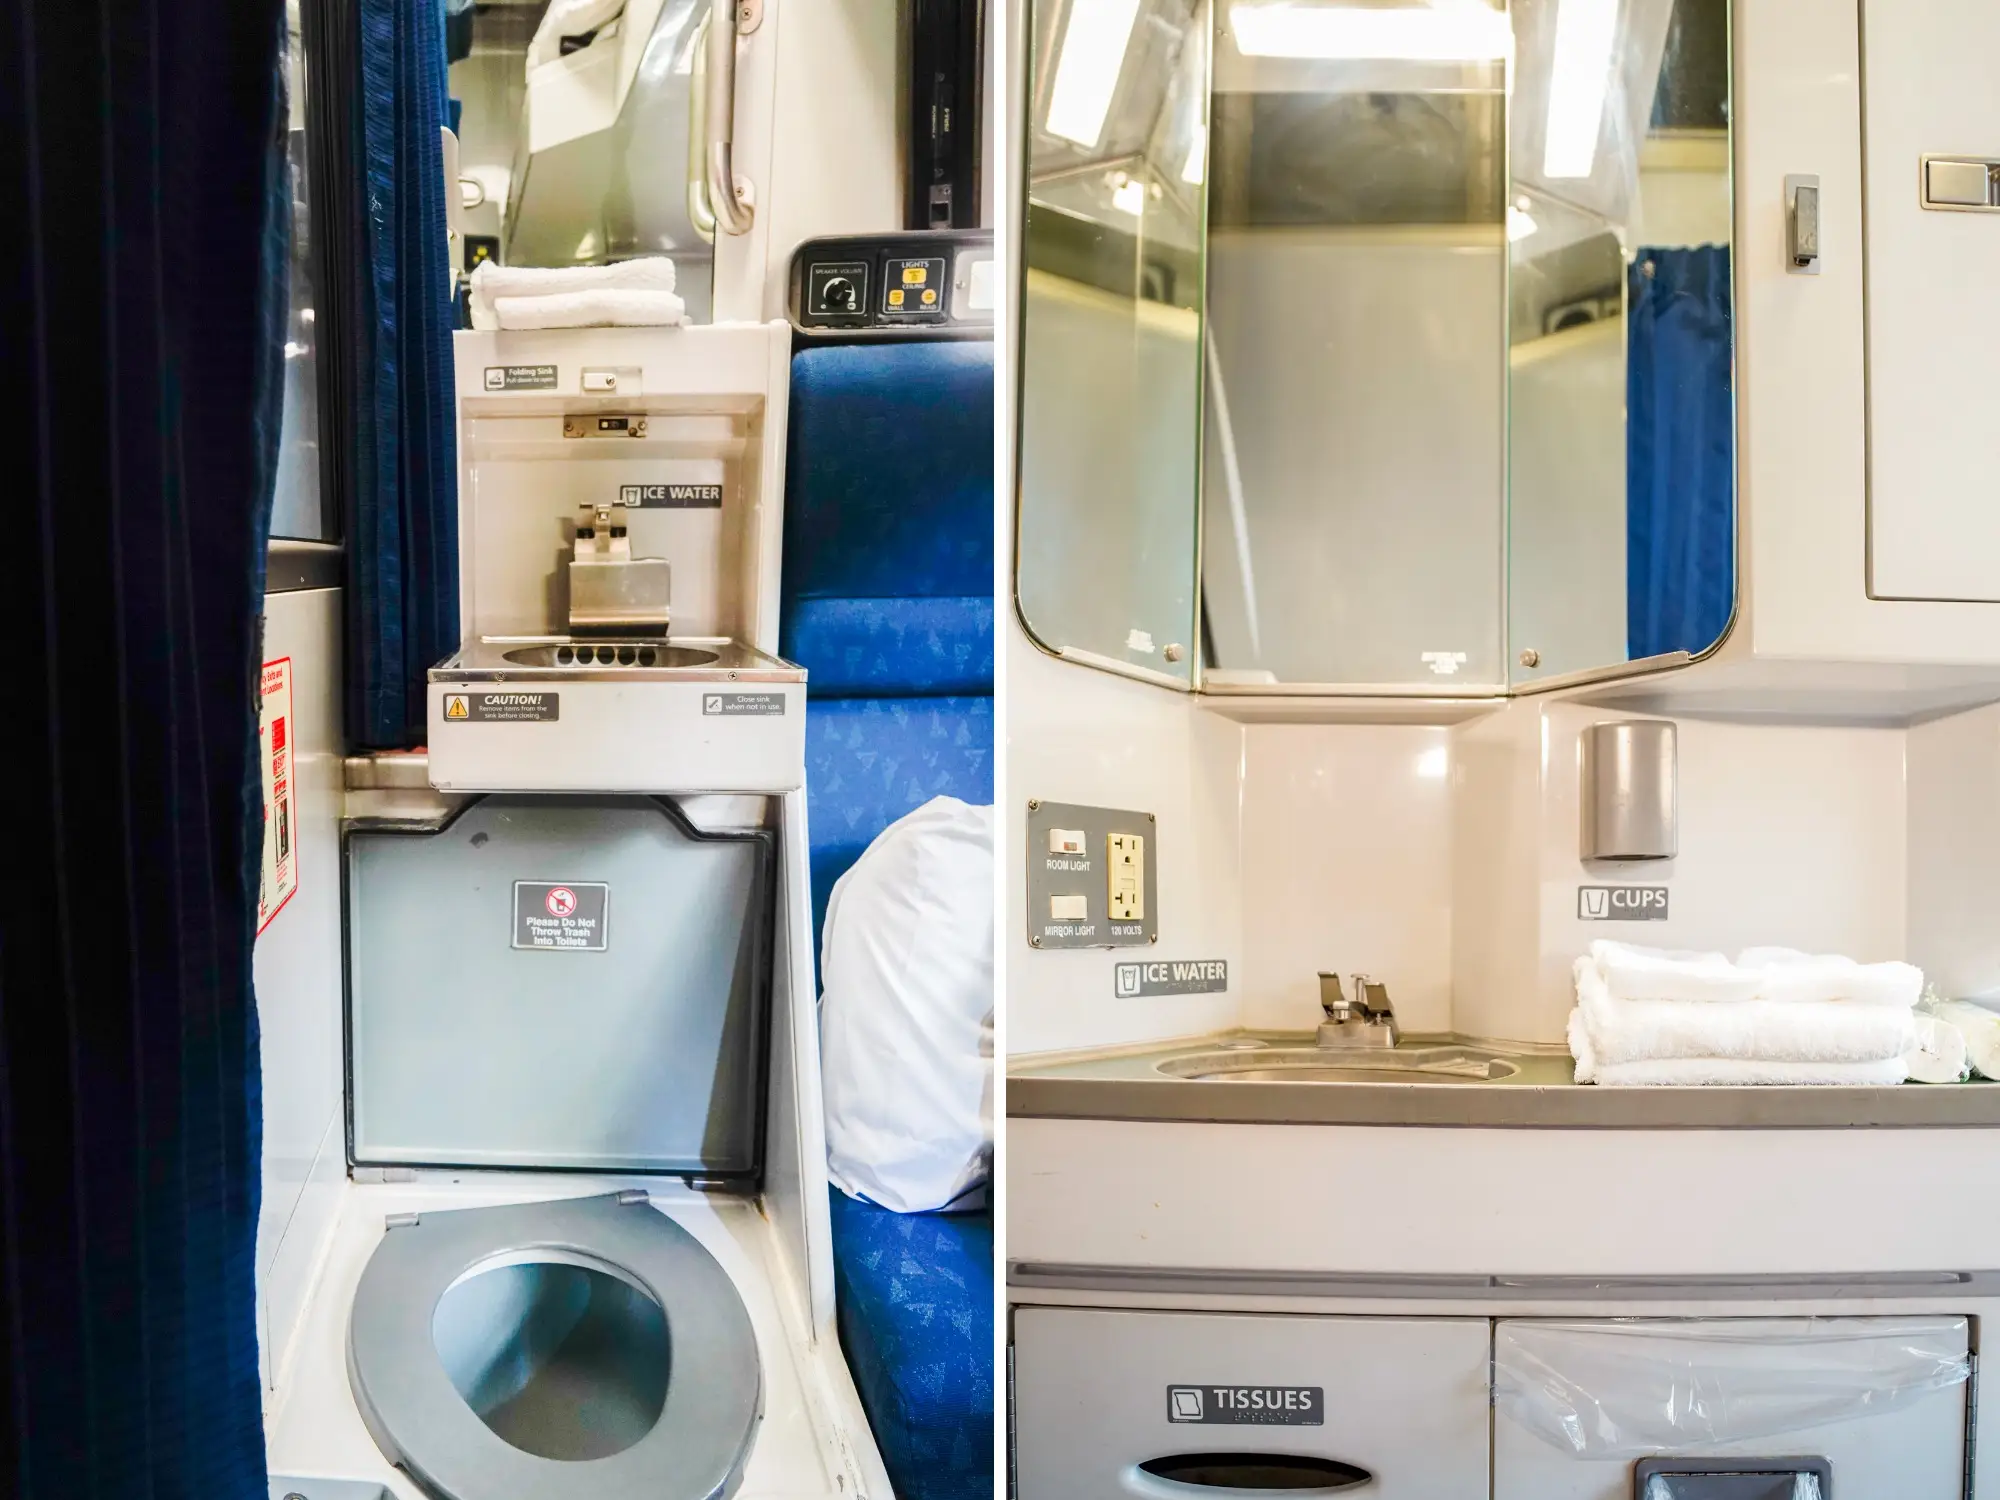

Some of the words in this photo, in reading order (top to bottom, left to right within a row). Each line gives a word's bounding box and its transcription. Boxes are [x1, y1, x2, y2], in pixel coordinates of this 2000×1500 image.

[508, 368, 536, 377] Folding
[537, 367, 554, 375] Sink
[643, 486, 665, 499] ICE
[669, 486, 720, 499] WATER
[484, 695, 542, 705] CAUTION!
[1046, 860, 1069, 870] ROOM
[1070, 860, 1091, 871] LIGHT
[1612, 890, 1666, 908] CUPS
[526, 917, 559, 927] Please
[561, 918, 576, 927] Do
[578, 918, 596, 928] Not
[531, 927, 562, 936] Throw
[563, 927, 591, 936] Trash
[1044, 926, 1074, 937] MIRROR
[1075, 926, 1095, 936] LIGHT
[1111, 925, 1121, 935] 120
[1123, 925, 1142, 935] VOLTS
[534, 936, 553, 945] Into
[555, 937, 587, 946] Toilets
[1143, 964, 1168, 983] ICE
[1172, 962, 1225, 981] WATER
[1213, 1389, 1312, 1410] TISSUES
